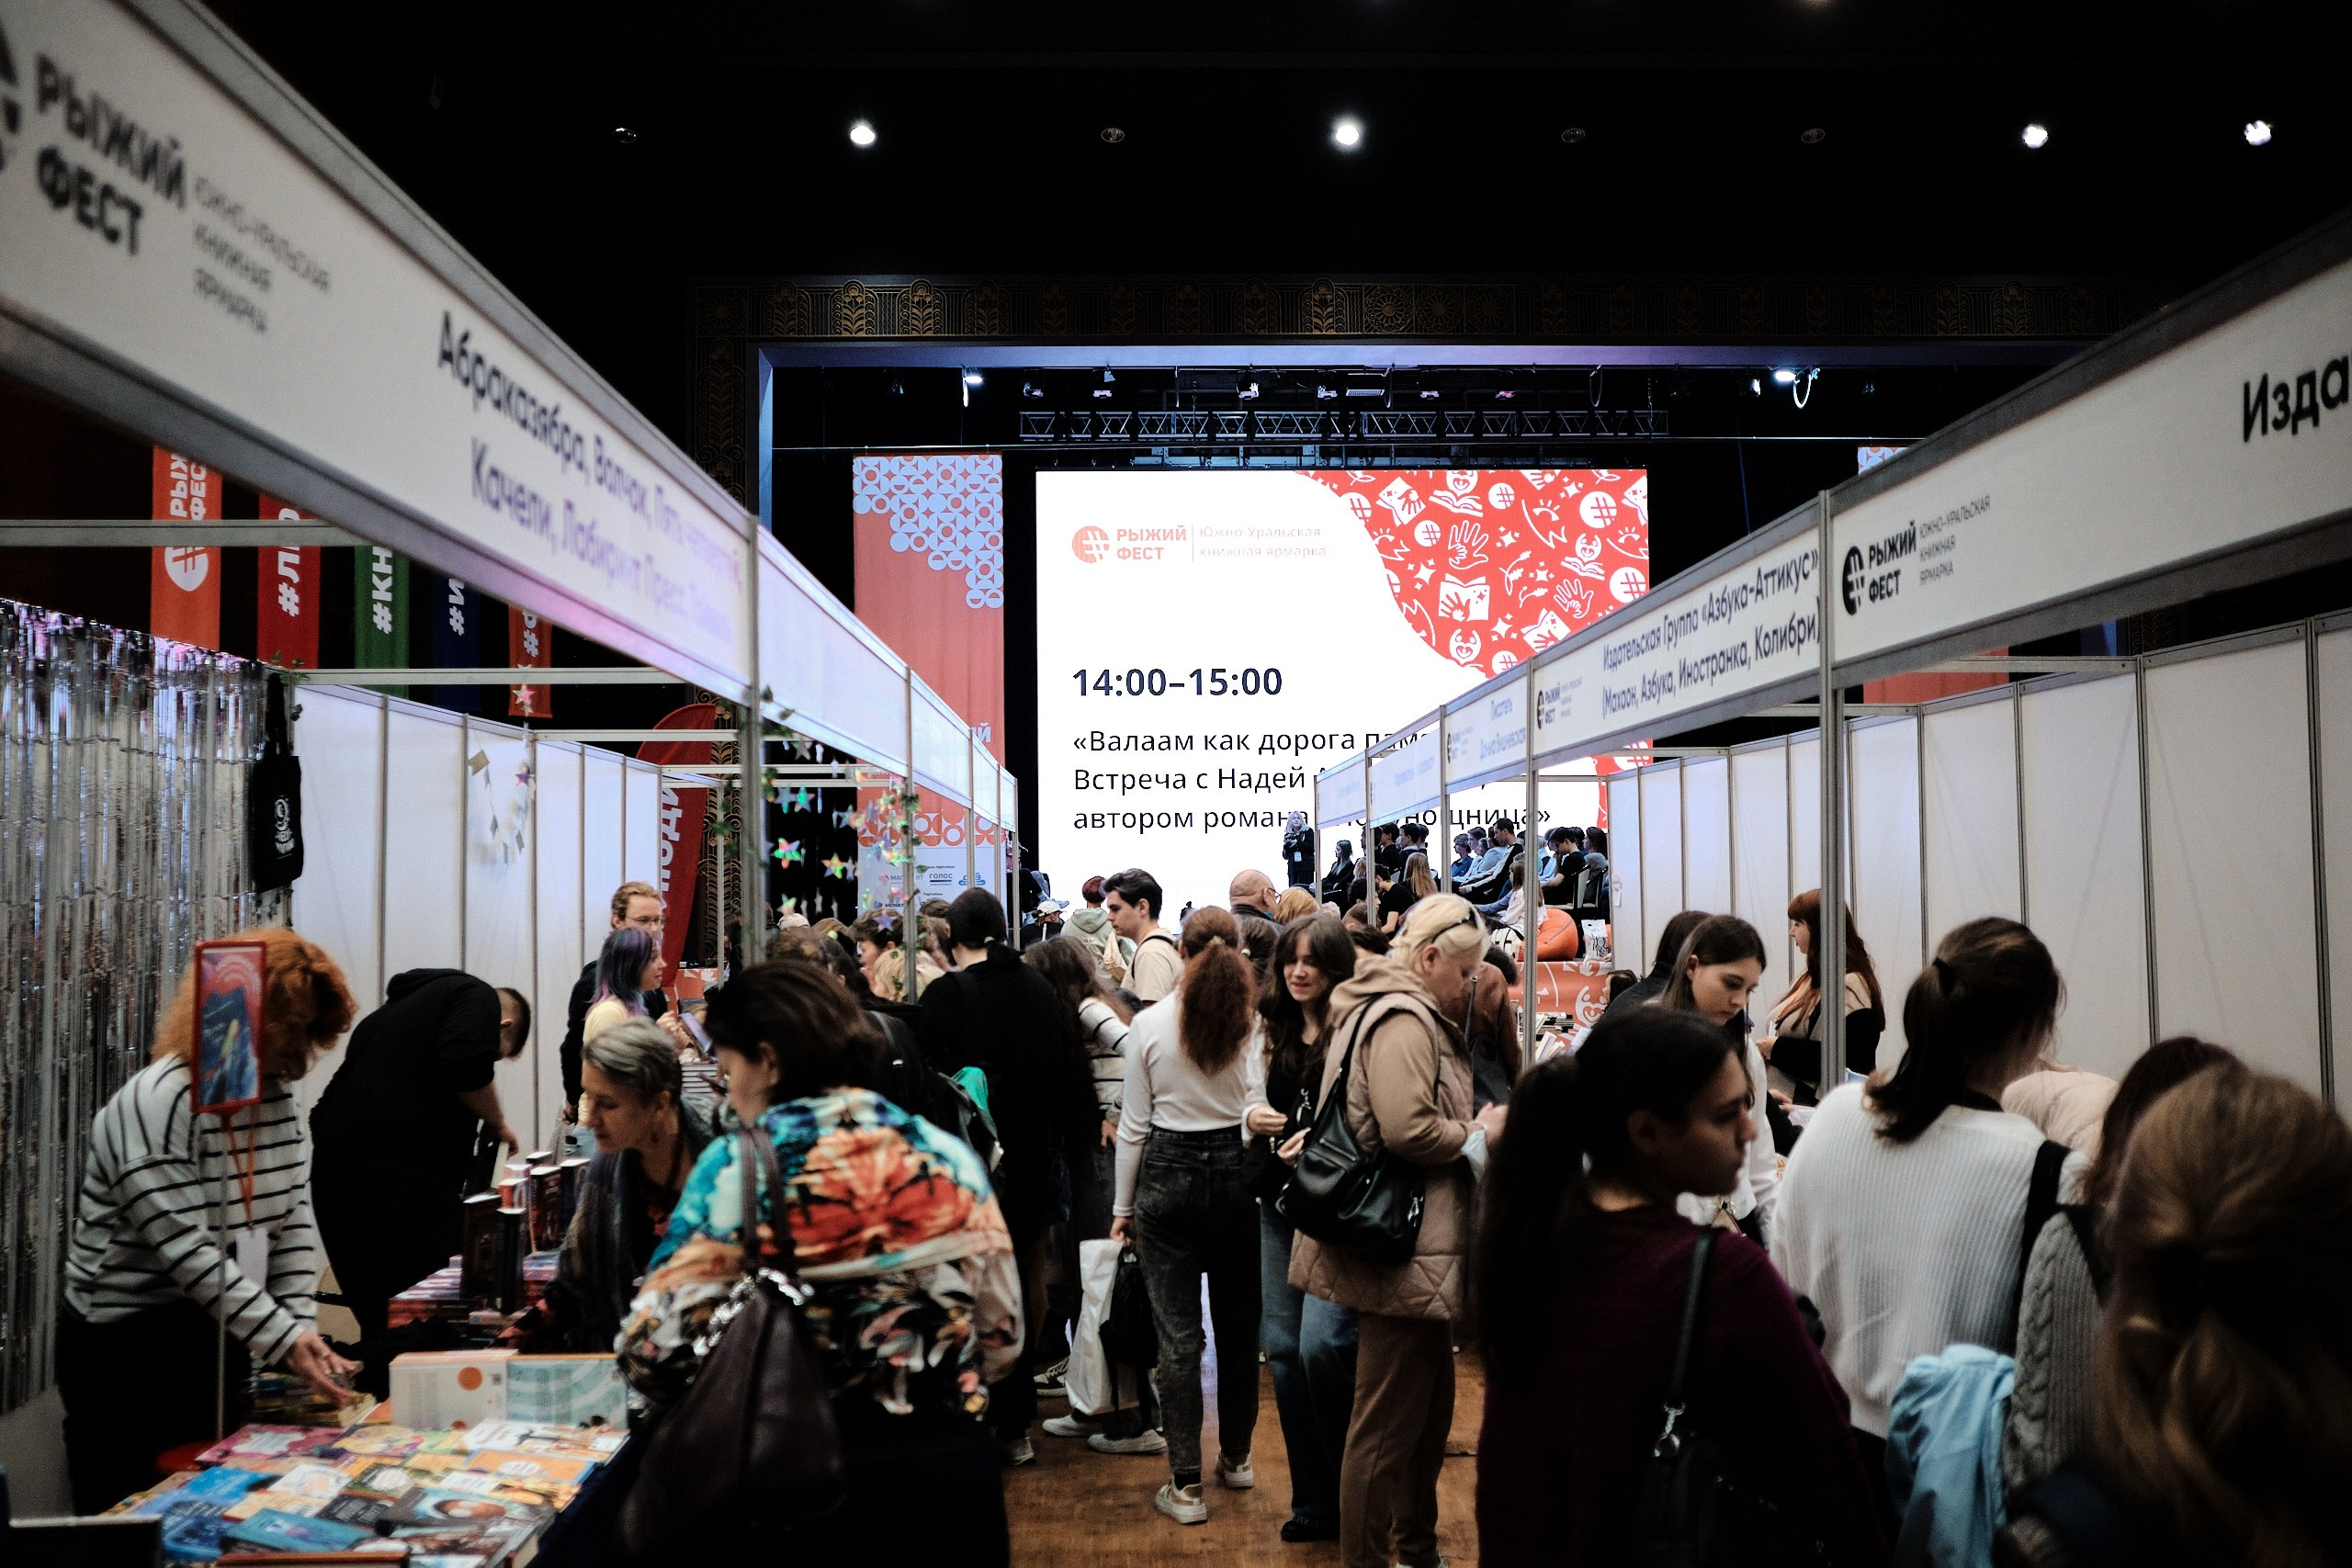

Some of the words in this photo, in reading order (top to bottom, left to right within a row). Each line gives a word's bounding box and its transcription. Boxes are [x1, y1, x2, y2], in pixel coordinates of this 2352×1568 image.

[37, 51, 187, 211] РЫЖИЙ
[37, 145, 144, 256] ФЕСТ
[1116, 525, 1187, 541] РЫЖИЙ
[1200, 526, 1320, 540] Южно-Уральская
[1869, 520, 1917, 570] РЫЖИЙ
[1919, 495, 1991, 539] ЮЖНО-УРАЛЬСКАЯ
[1919, 535, 1956, 562] КНИЖНАЯ
[1116, 547, 1164, 560] ФЕСТ
[1200, 547, 1261, 557] книжная
[1267, 547, 1326, 558] ярмарка
[1869, 569, 1901, 604] ФЕСТ
[1919, 560, 1954, 586] ЯРМАРКА
[1603, 629, 1661, 672] Издательская
[1664, 606, 1699, 650] Группа
[1702, 549, 1820, 625] «Азбука-Аттикус»
[1602, 685, 1639, 720] (Махаон,
[1641, 671, 1677, 705] Азбука,
[1679, 641, 1751, 686] Иностранка,
[1756, 596, 1821, 661] Колибри)
[1073, 730, 1193, 751] «Валаам
[1204, 733, 1250, 751] как
[1259, 733, 1355, 756] дорога
[1075, 769, 1186, 795] Встреча
[1196, 772, 1208, 789] с
[1218, 766, 1305, 794] Надей
[1073, 811, 1193, 834] автором
